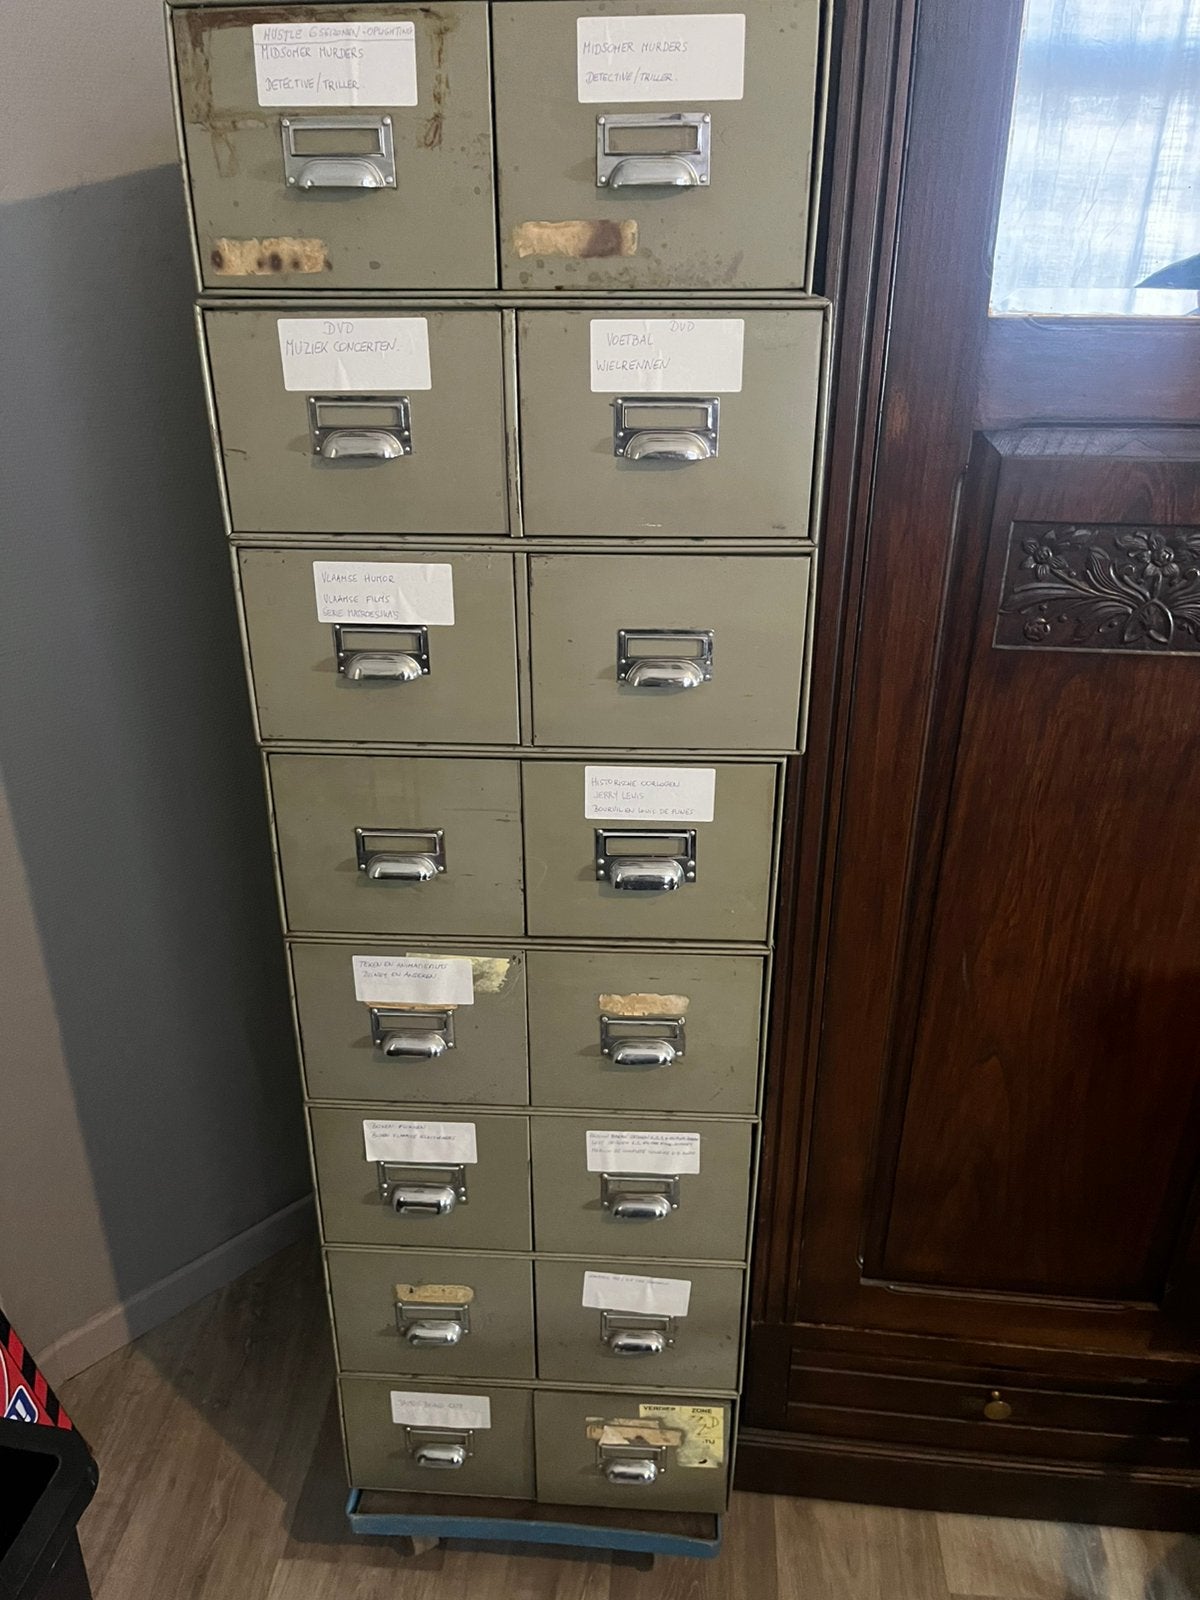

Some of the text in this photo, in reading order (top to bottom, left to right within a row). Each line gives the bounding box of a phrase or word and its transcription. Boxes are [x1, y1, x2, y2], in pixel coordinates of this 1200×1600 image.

[263, 26, 302, 42] HUSTLE
[261, 44, 365, 60] MIDSOMER MURDERS
[582, 41, 689, 55] MIDSOMER MURDERS
[323, 321, 355, 336] DVD
[670, 320, 696, 333] DVD
[606, 332, 654, 347] VOETBAL
[285, 339, 329, 356] MUZIEK
[596, 358, 671, 372] WIELRENNEN
[321, 571, 396, 584] VLAAMSE HUMOR
[323, 594, 391, 604] VLAAMSE FILMS
[593, 790, 619, 801] JERRY
